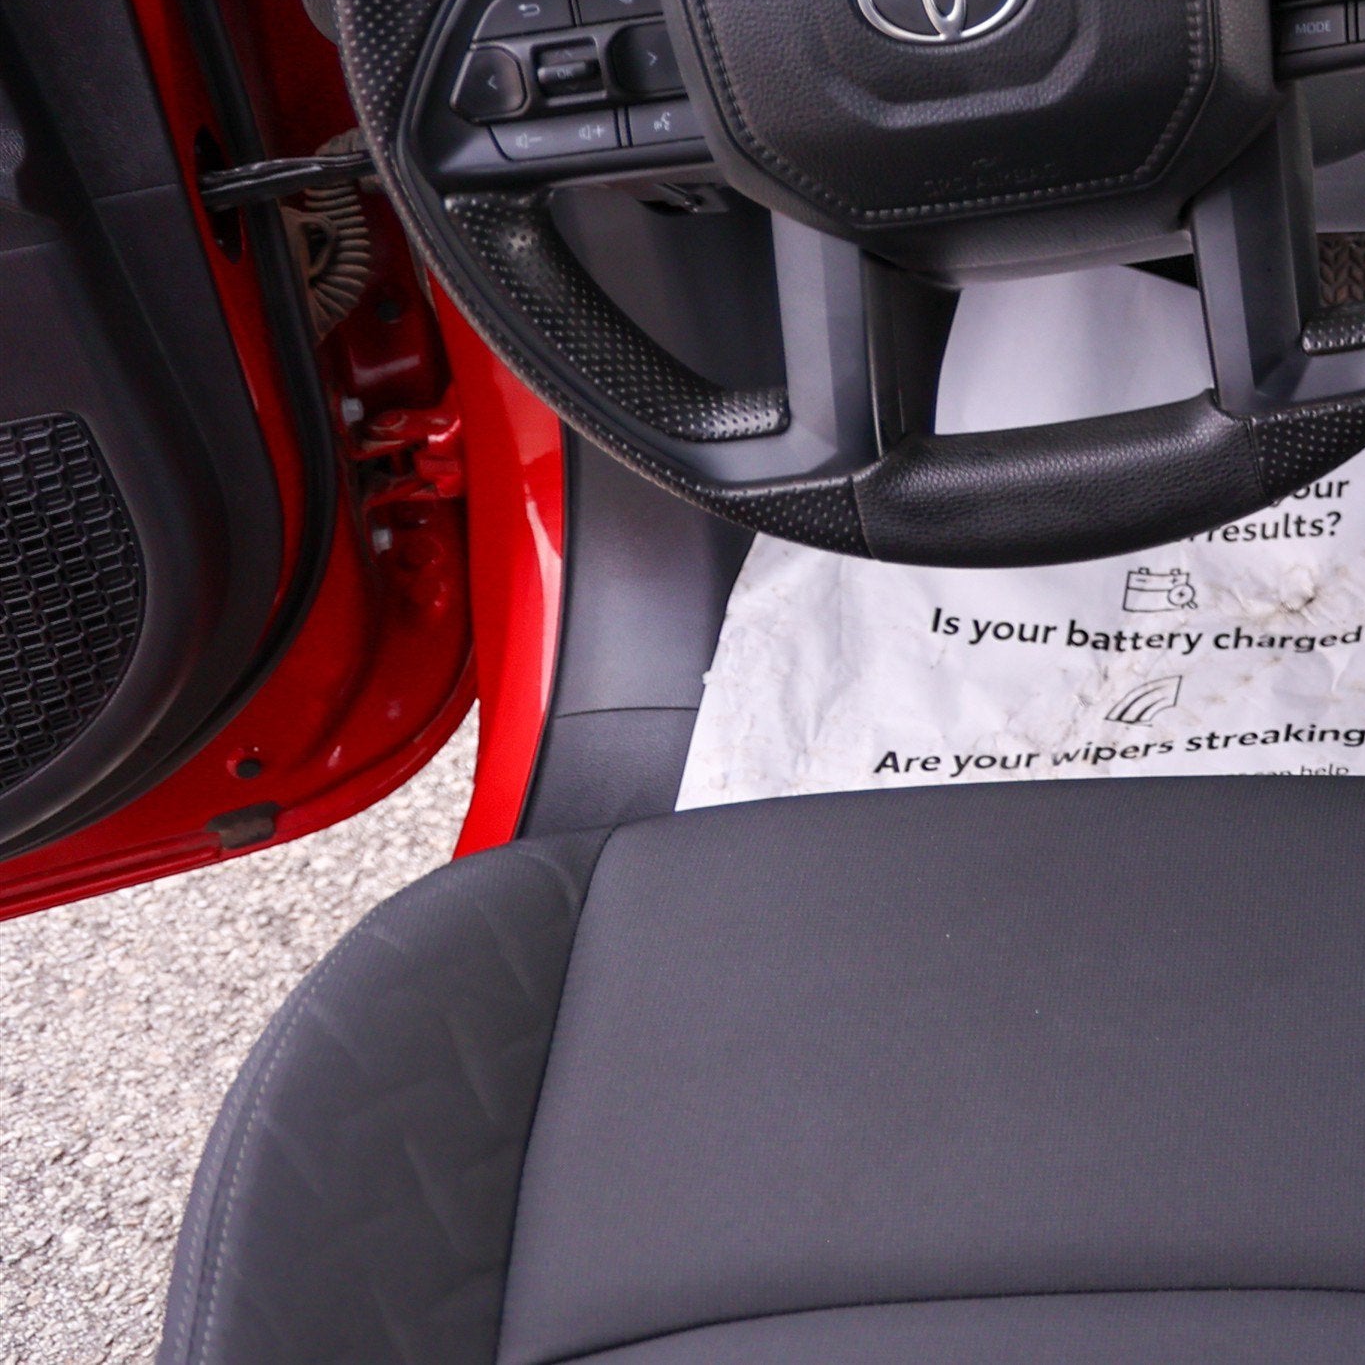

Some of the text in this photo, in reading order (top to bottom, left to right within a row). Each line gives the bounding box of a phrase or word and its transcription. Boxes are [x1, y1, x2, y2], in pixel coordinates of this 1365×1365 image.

[1295, 19, 1332, 35] MODE
[1270, 479, 1350, 508] our
[1206, 511, 1342, 543] results?
[931, 607, 960, 635] Is
[968, 619, 1057, 645] your
[1066, 620, 1203, 655] battery
[873, 751, 942, 775] Are
[950, 750, 1041, 777] your
[1051, 737, 1175, 767] wipers
